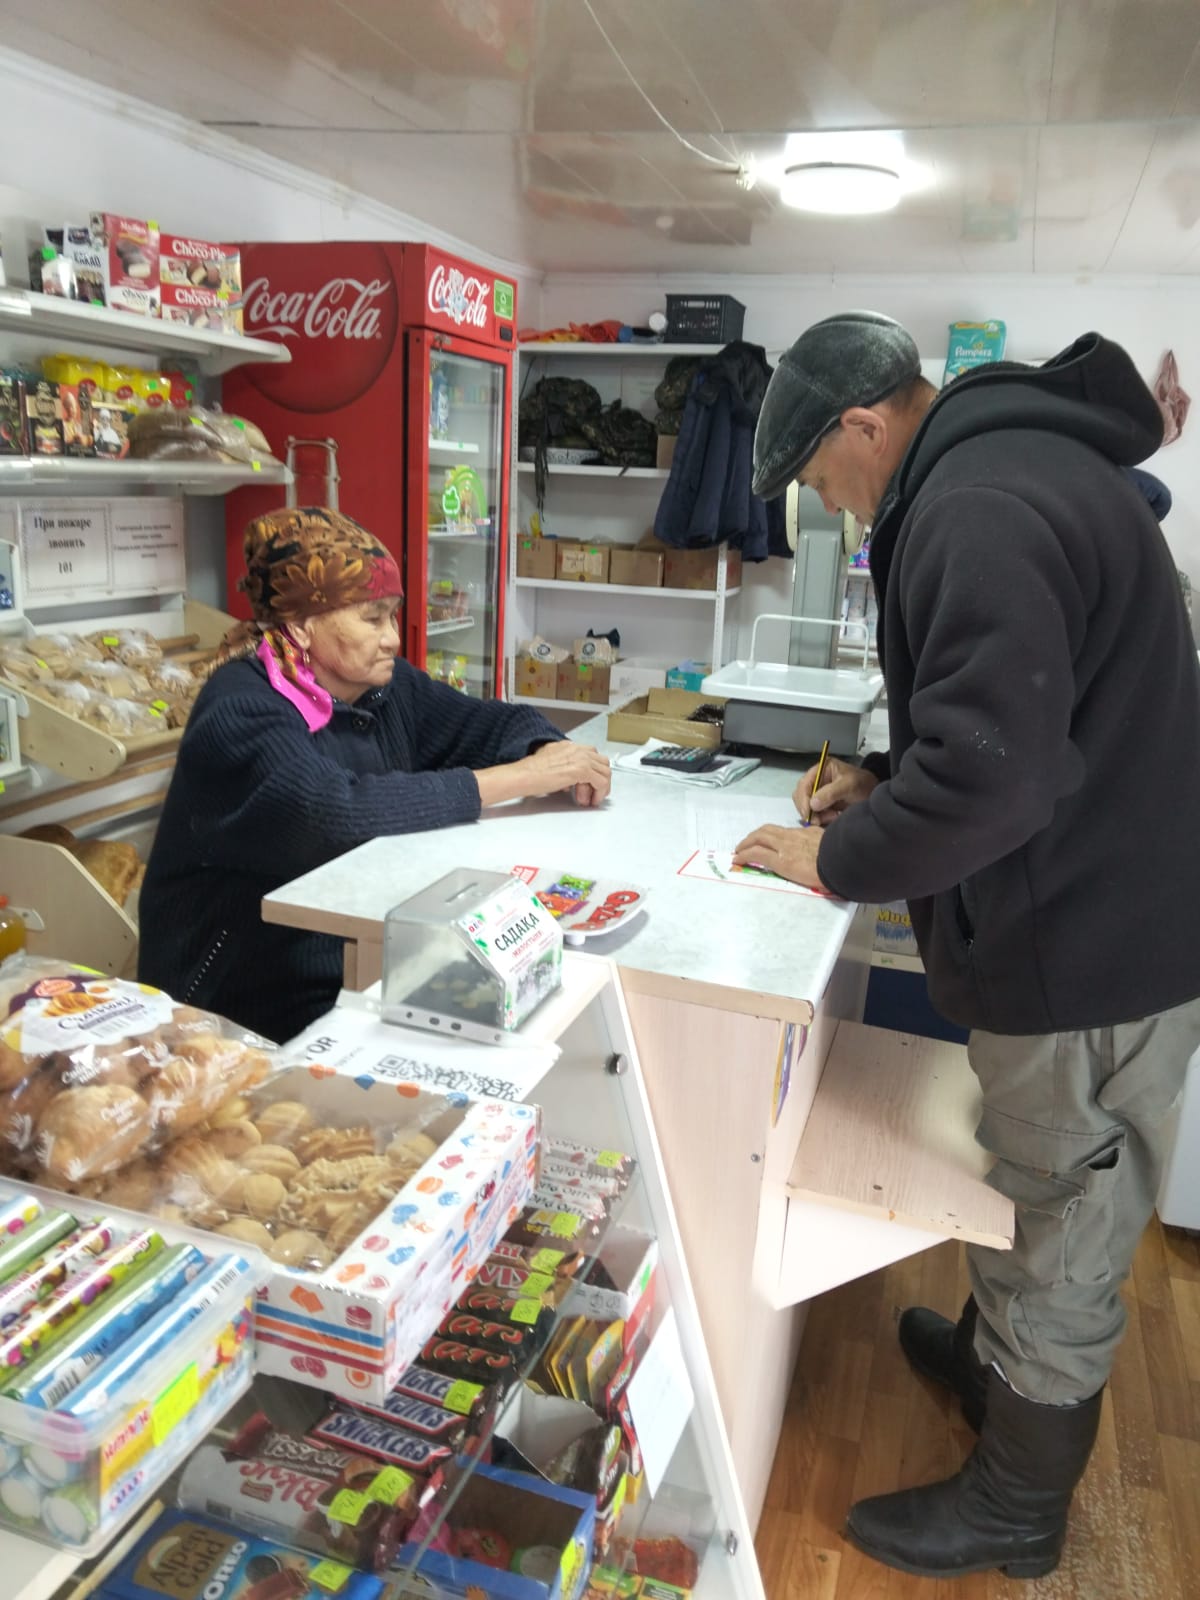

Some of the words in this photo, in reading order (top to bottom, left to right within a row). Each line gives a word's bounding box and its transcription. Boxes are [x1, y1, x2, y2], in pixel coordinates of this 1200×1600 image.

[242, 277, 392, 340] Coca-Cola
[430, 264, 490, 327] CocCola
[34, 516, 55, 533] При
[57, 517, 92, 532] пожаре
[48, 538, 86, 550] звонить
[58, 561, 73, 575] 101
[493, 911, 541, 952] САДАҚА
[456, 1291, 517, 1311] ar
[323, 1413, 431, 1463] SNICKERS
[152, 1526, 205, 1588] Alpen
[174, 1540, 226, 1592] Gold
[203, 1540, 248, 1600] OREO
